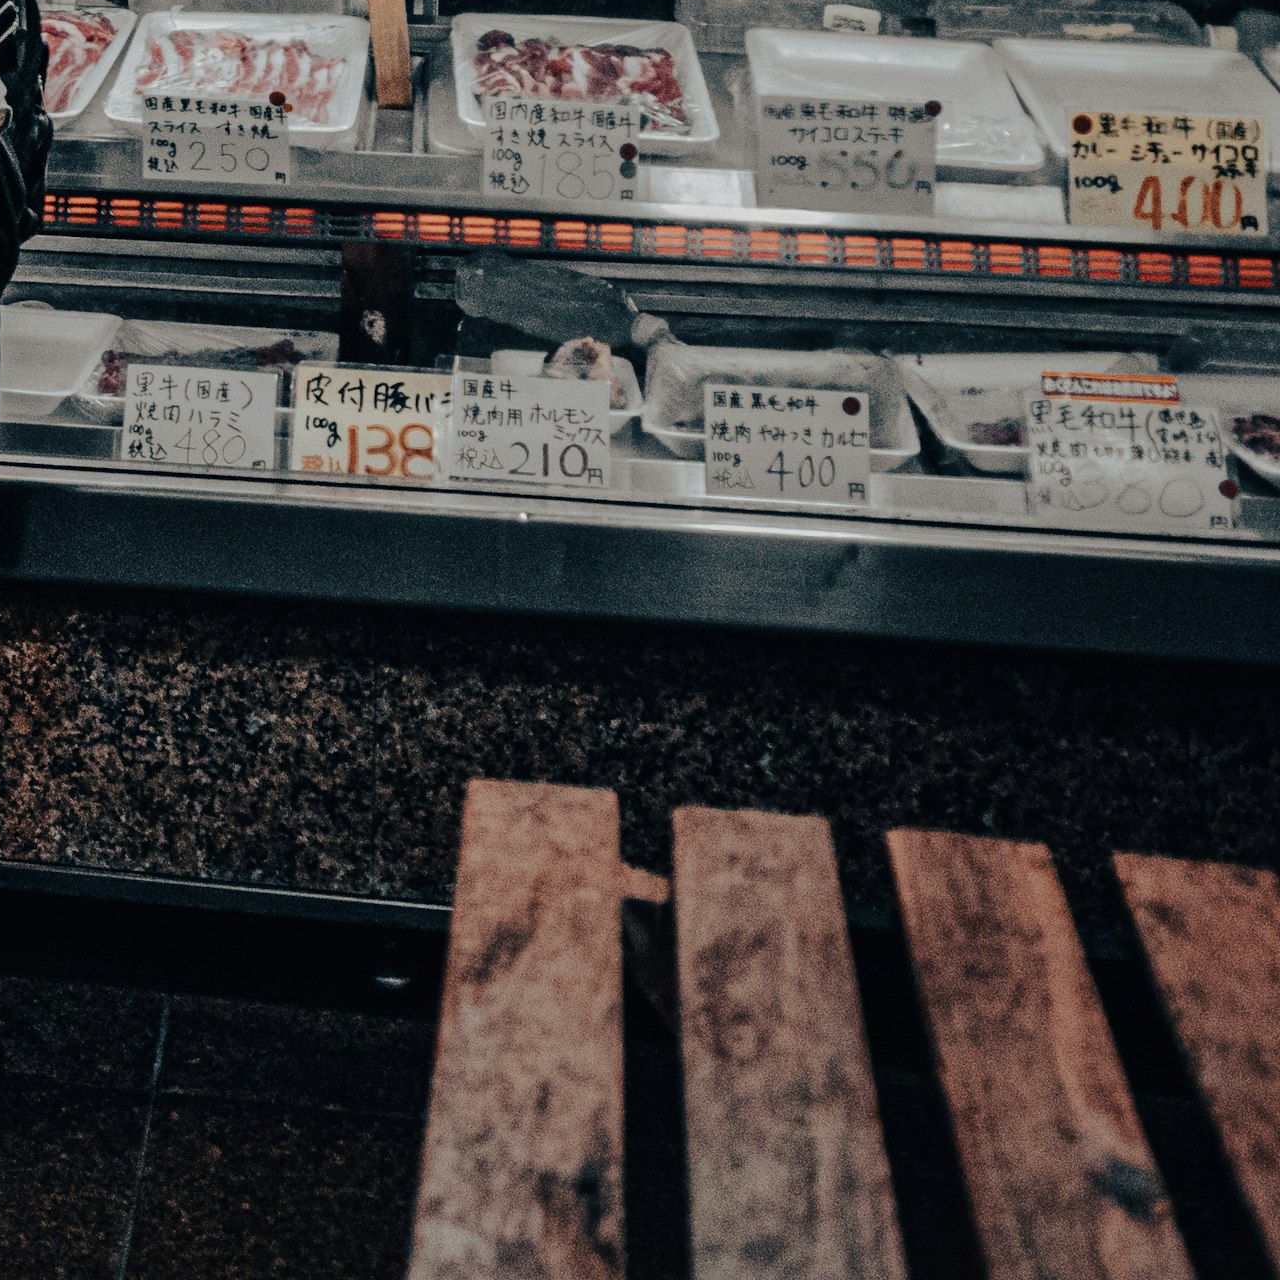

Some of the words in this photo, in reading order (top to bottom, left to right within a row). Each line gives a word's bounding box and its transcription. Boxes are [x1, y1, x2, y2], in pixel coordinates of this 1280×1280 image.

[148, 120, 202, 135] スライス
[149, 137, 178, 158] 100g
[558, 132, 615, 153] スライス
[492, 148, 523, 171] 100g
[460, 378, 519, 399] 国産牛
[134, 401, 243, 432] 焼肉ハラミ
[127, 423, 157, 448] 100g
[303, 413, 343, 447] 100g
[456, 426, 487, 440] 100g
[553, 423, 608, 447] ミックス
[127, 441, 168, 461] 税込
[455, 445, 505, 470] 税込
[711, 449, 742, 465] 100g
